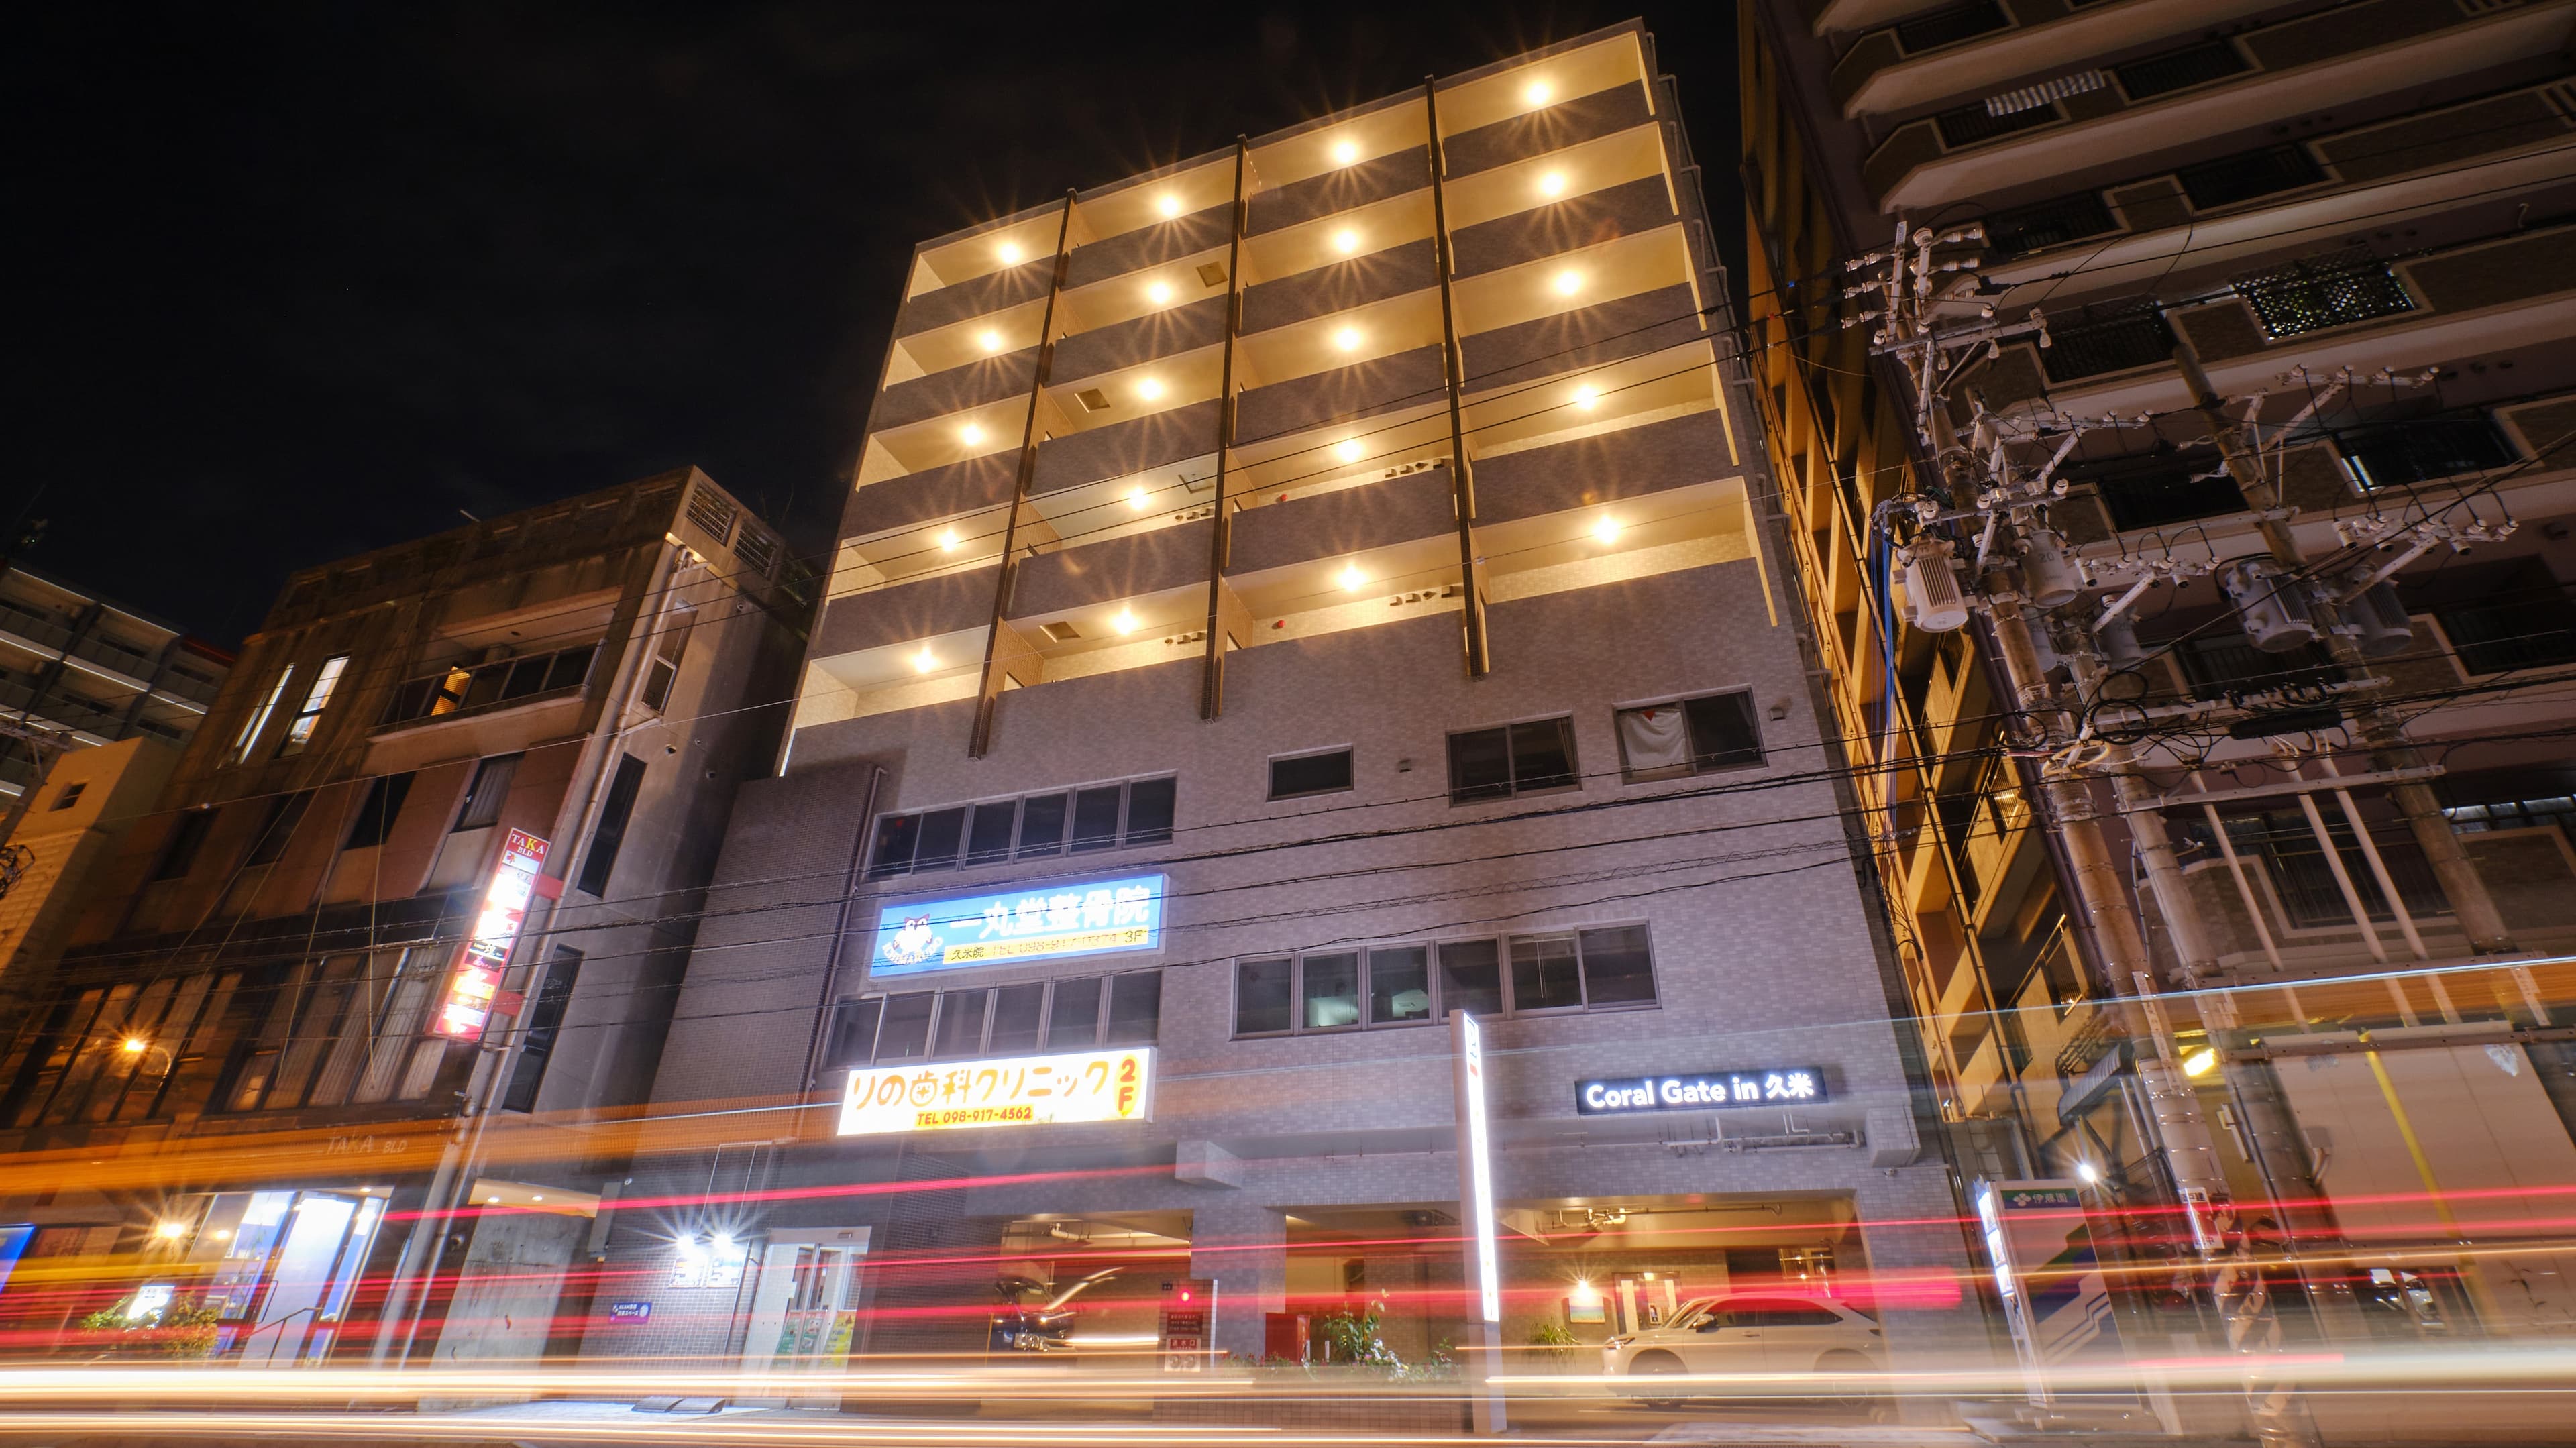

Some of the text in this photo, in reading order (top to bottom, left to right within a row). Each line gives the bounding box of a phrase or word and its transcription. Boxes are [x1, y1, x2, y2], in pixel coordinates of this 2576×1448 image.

[2038, 552, 2055, 564] 20
[512, 834, 544, 854] TAKA
[517, 846, 533, 857] BLD
[949, 885, 1151, 939] 一丸堂整骨院
[951, 946, 984, 961] 久米院
[1124, 930, 1143, 944] 3F
[1118, 1058, 1136, 1111] 2F
[1586, 1072, 1815, 1107] Coral Gate in 久米
[917, 1107, 1032, 1125] TEL 098-917-4562
[382, 1139, 407, 1153] BLD
[2032, 1192, 2068, 1204] 伊藤園
